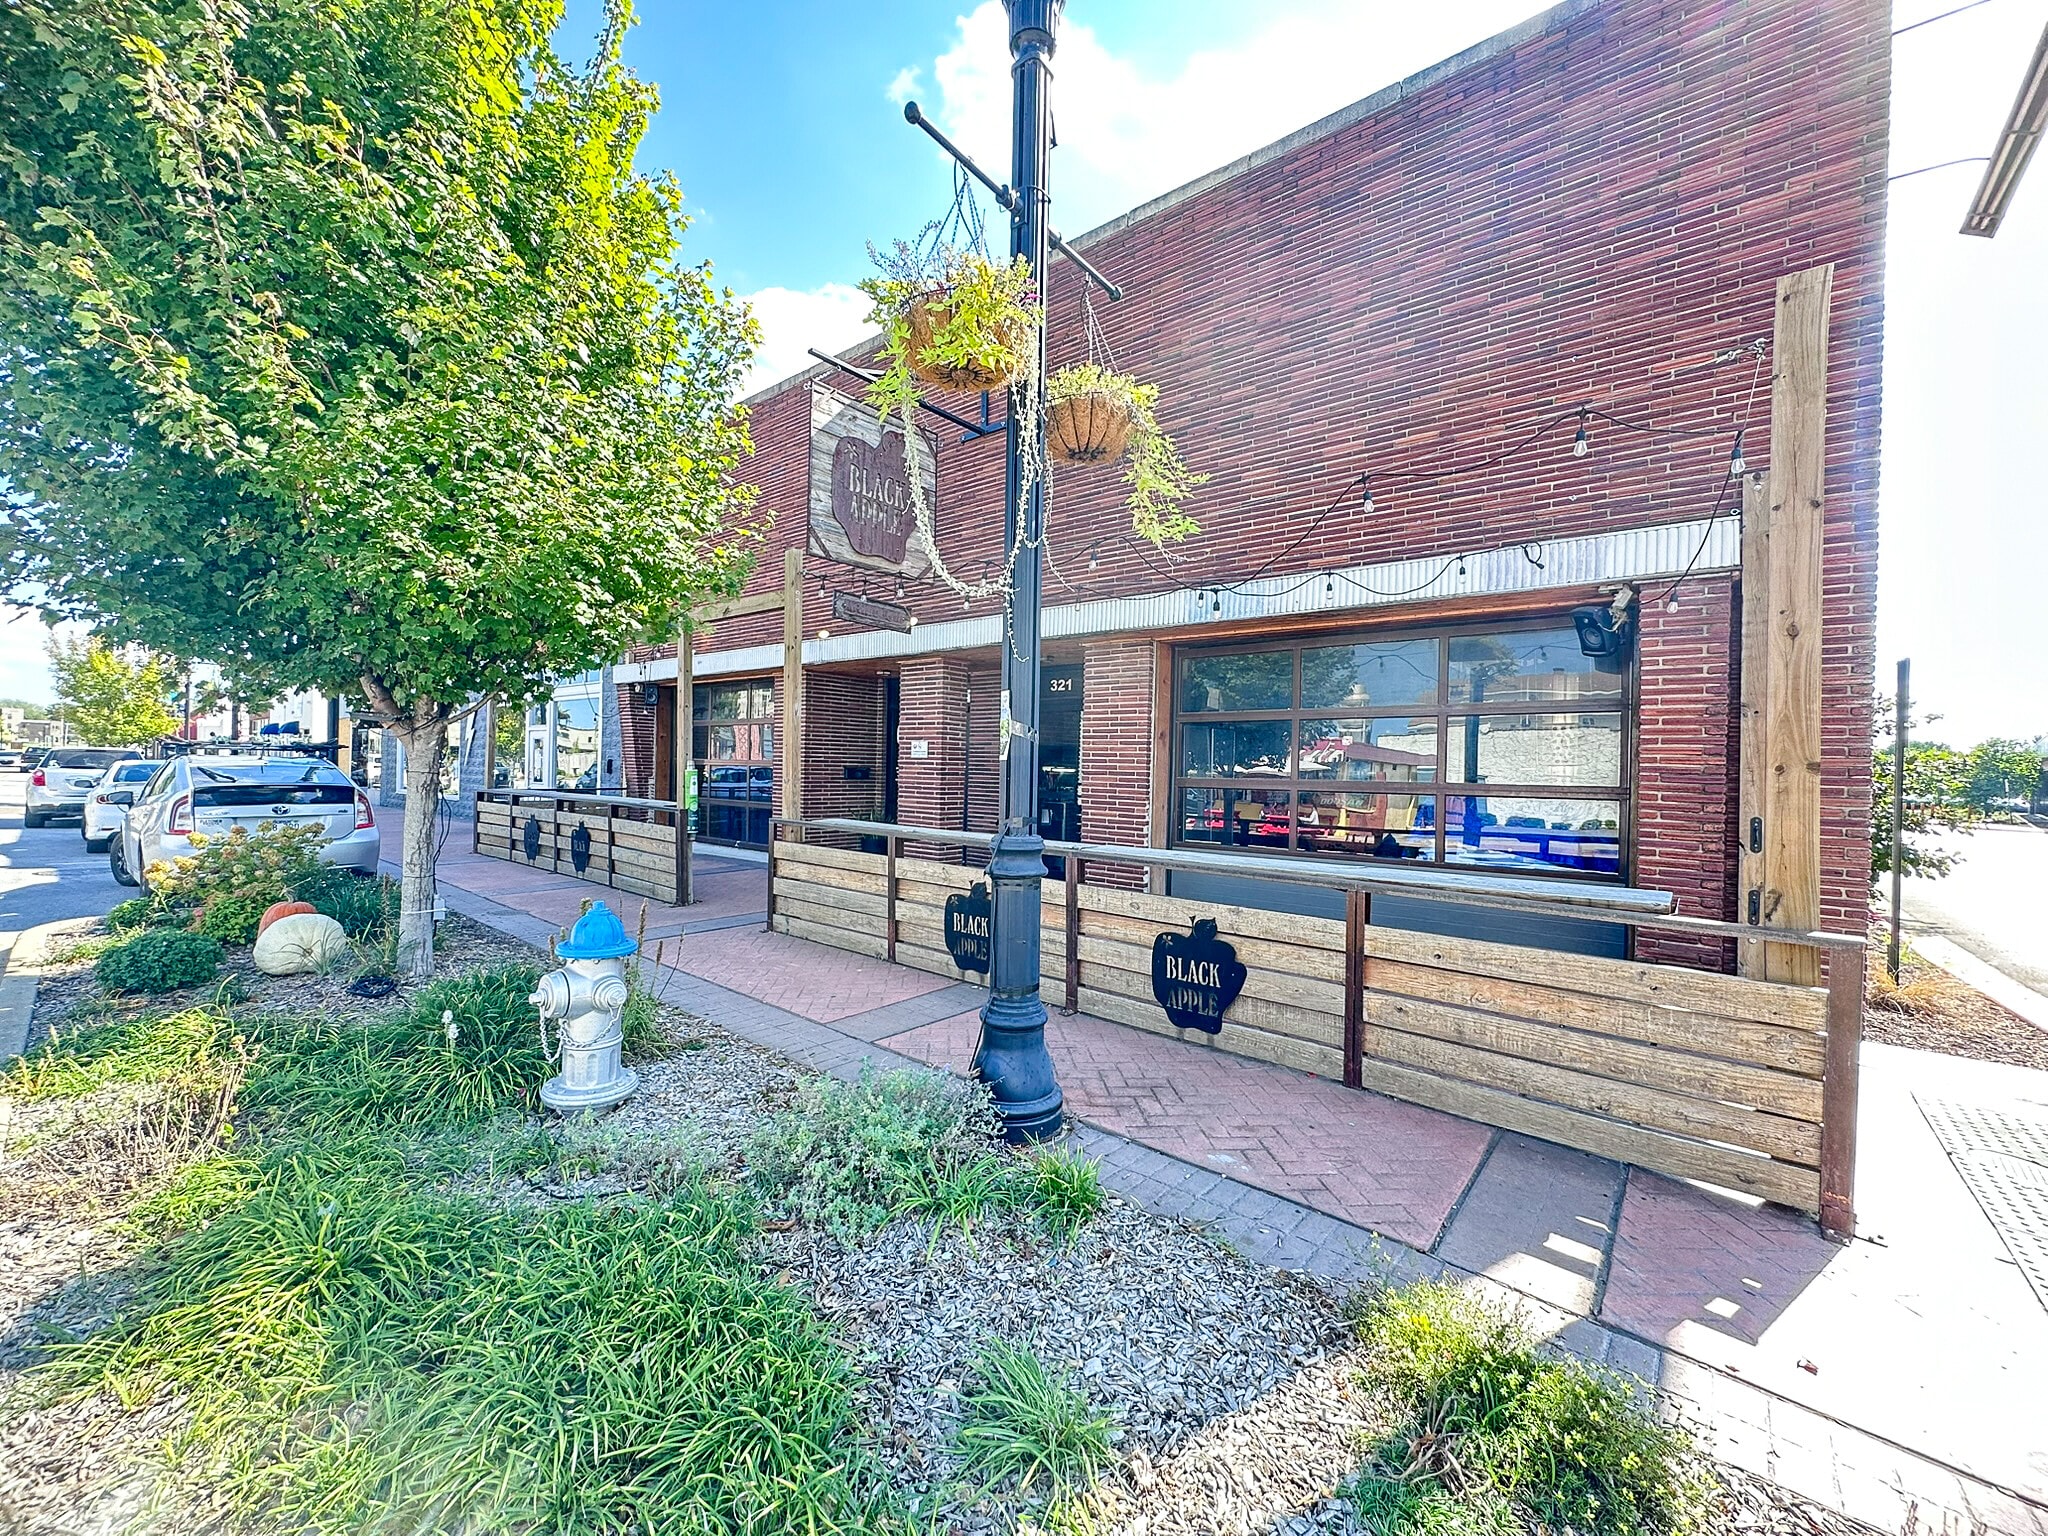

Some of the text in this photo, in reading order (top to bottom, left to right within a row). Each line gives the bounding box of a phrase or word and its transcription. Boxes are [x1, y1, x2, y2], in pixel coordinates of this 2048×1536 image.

[849, 463, 905, 510] BLACK
[849, 494, 902, 536] APPLE
[1050, 678, 1072, 691] 321
[953, 912, 989, 938] BLACK
[953, 937, 988, 961] APPLE
[1166, 955, 1221, 988] BLACK
[1166, 987, 1219, 1018] APPLE
